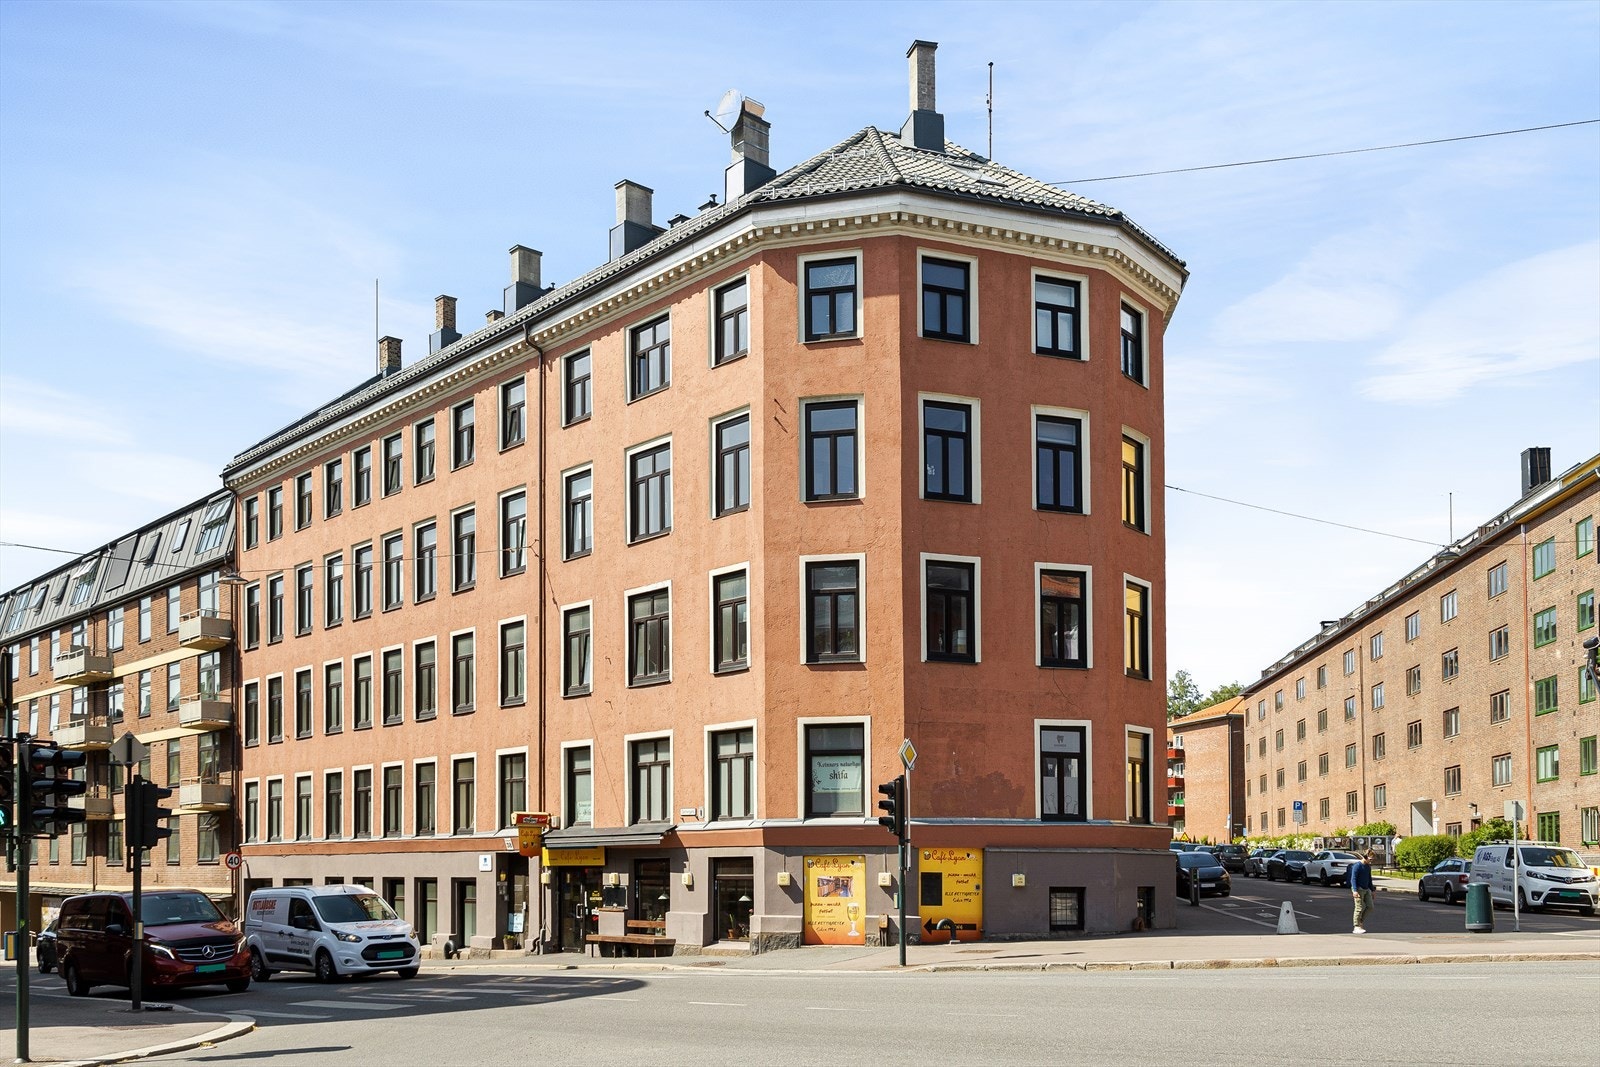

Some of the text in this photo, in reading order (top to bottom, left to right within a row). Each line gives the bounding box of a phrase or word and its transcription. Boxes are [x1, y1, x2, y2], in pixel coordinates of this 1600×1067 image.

[829, 769, 848, 780] shifa
[228, 856, 240, 866] 40
[1482, 851, 1492, 861] AGS
